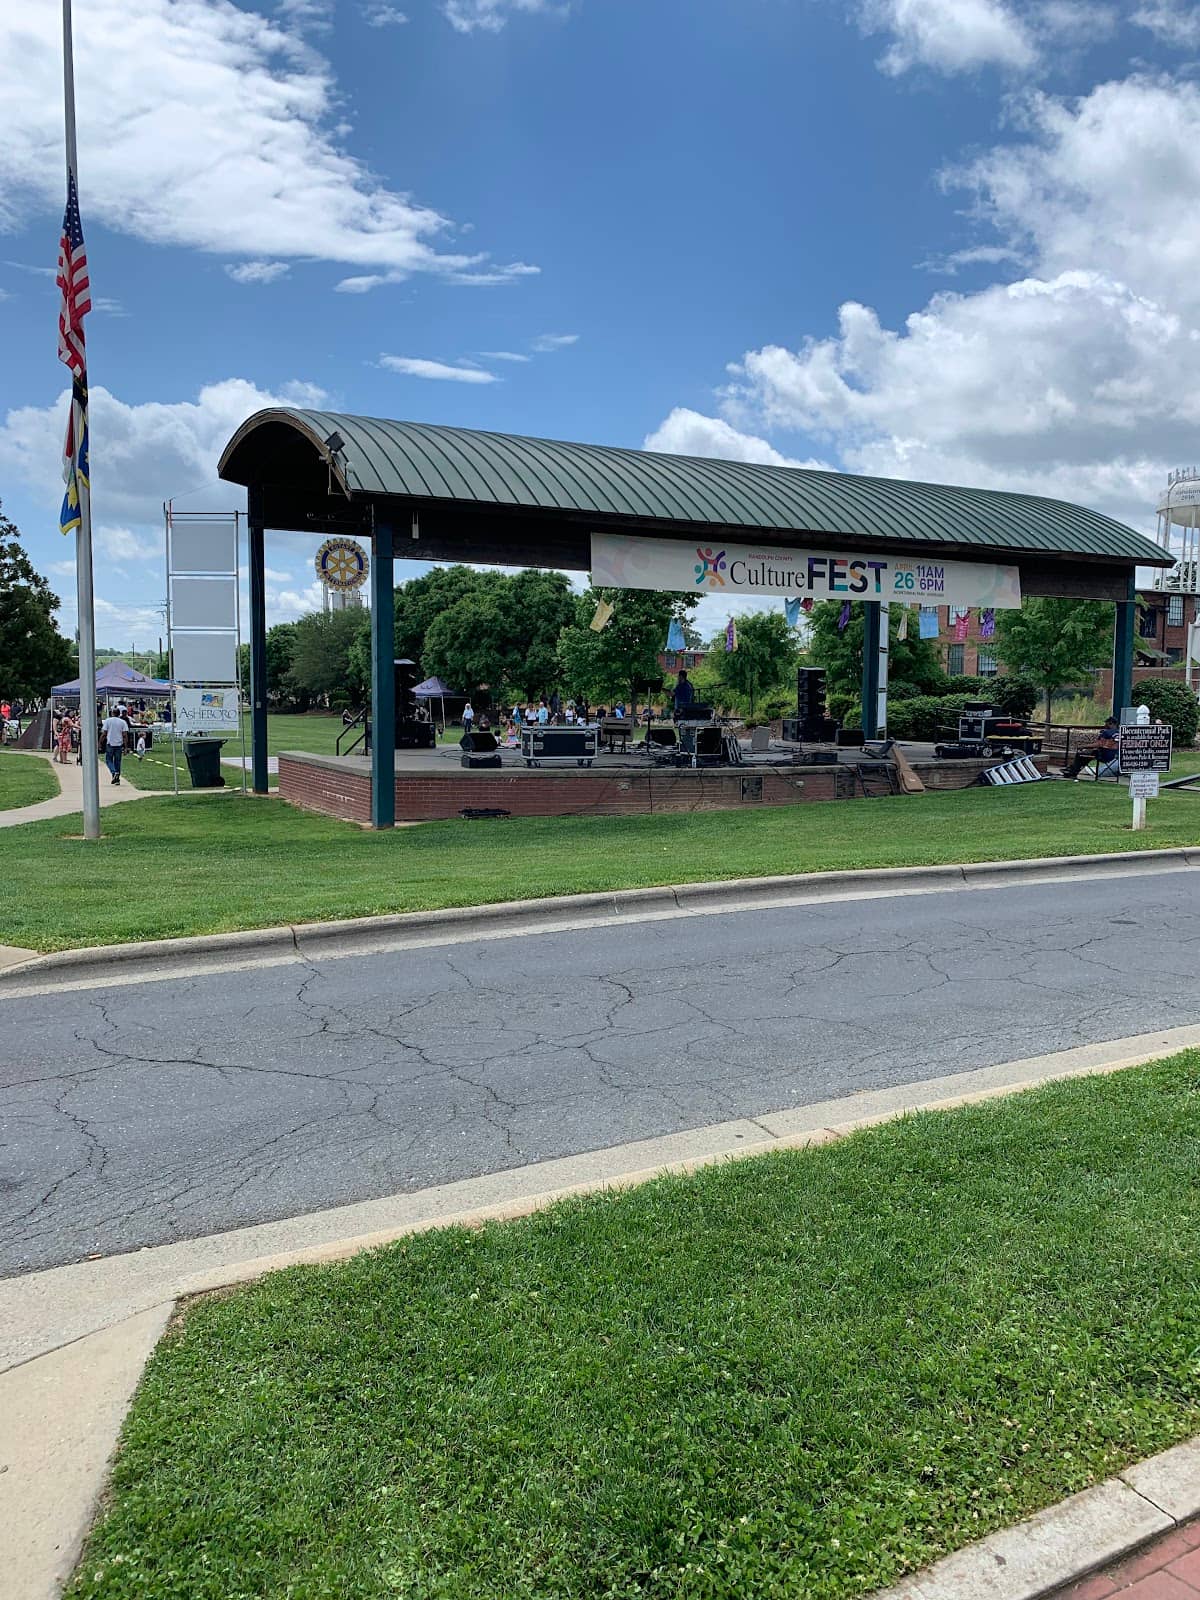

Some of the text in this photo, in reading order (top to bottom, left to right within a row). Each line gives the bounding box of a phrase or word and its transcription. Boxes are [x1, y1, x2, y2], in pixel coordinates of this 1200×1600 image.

[915, 565, 944, 579] 11AM
[894, 571, 914, 589] 26
[919, 578, 944, 592] 6PM
[1157, 726, 1170, 734] Park
[1121, 739, 1169, 748] PERMIT ONLY
